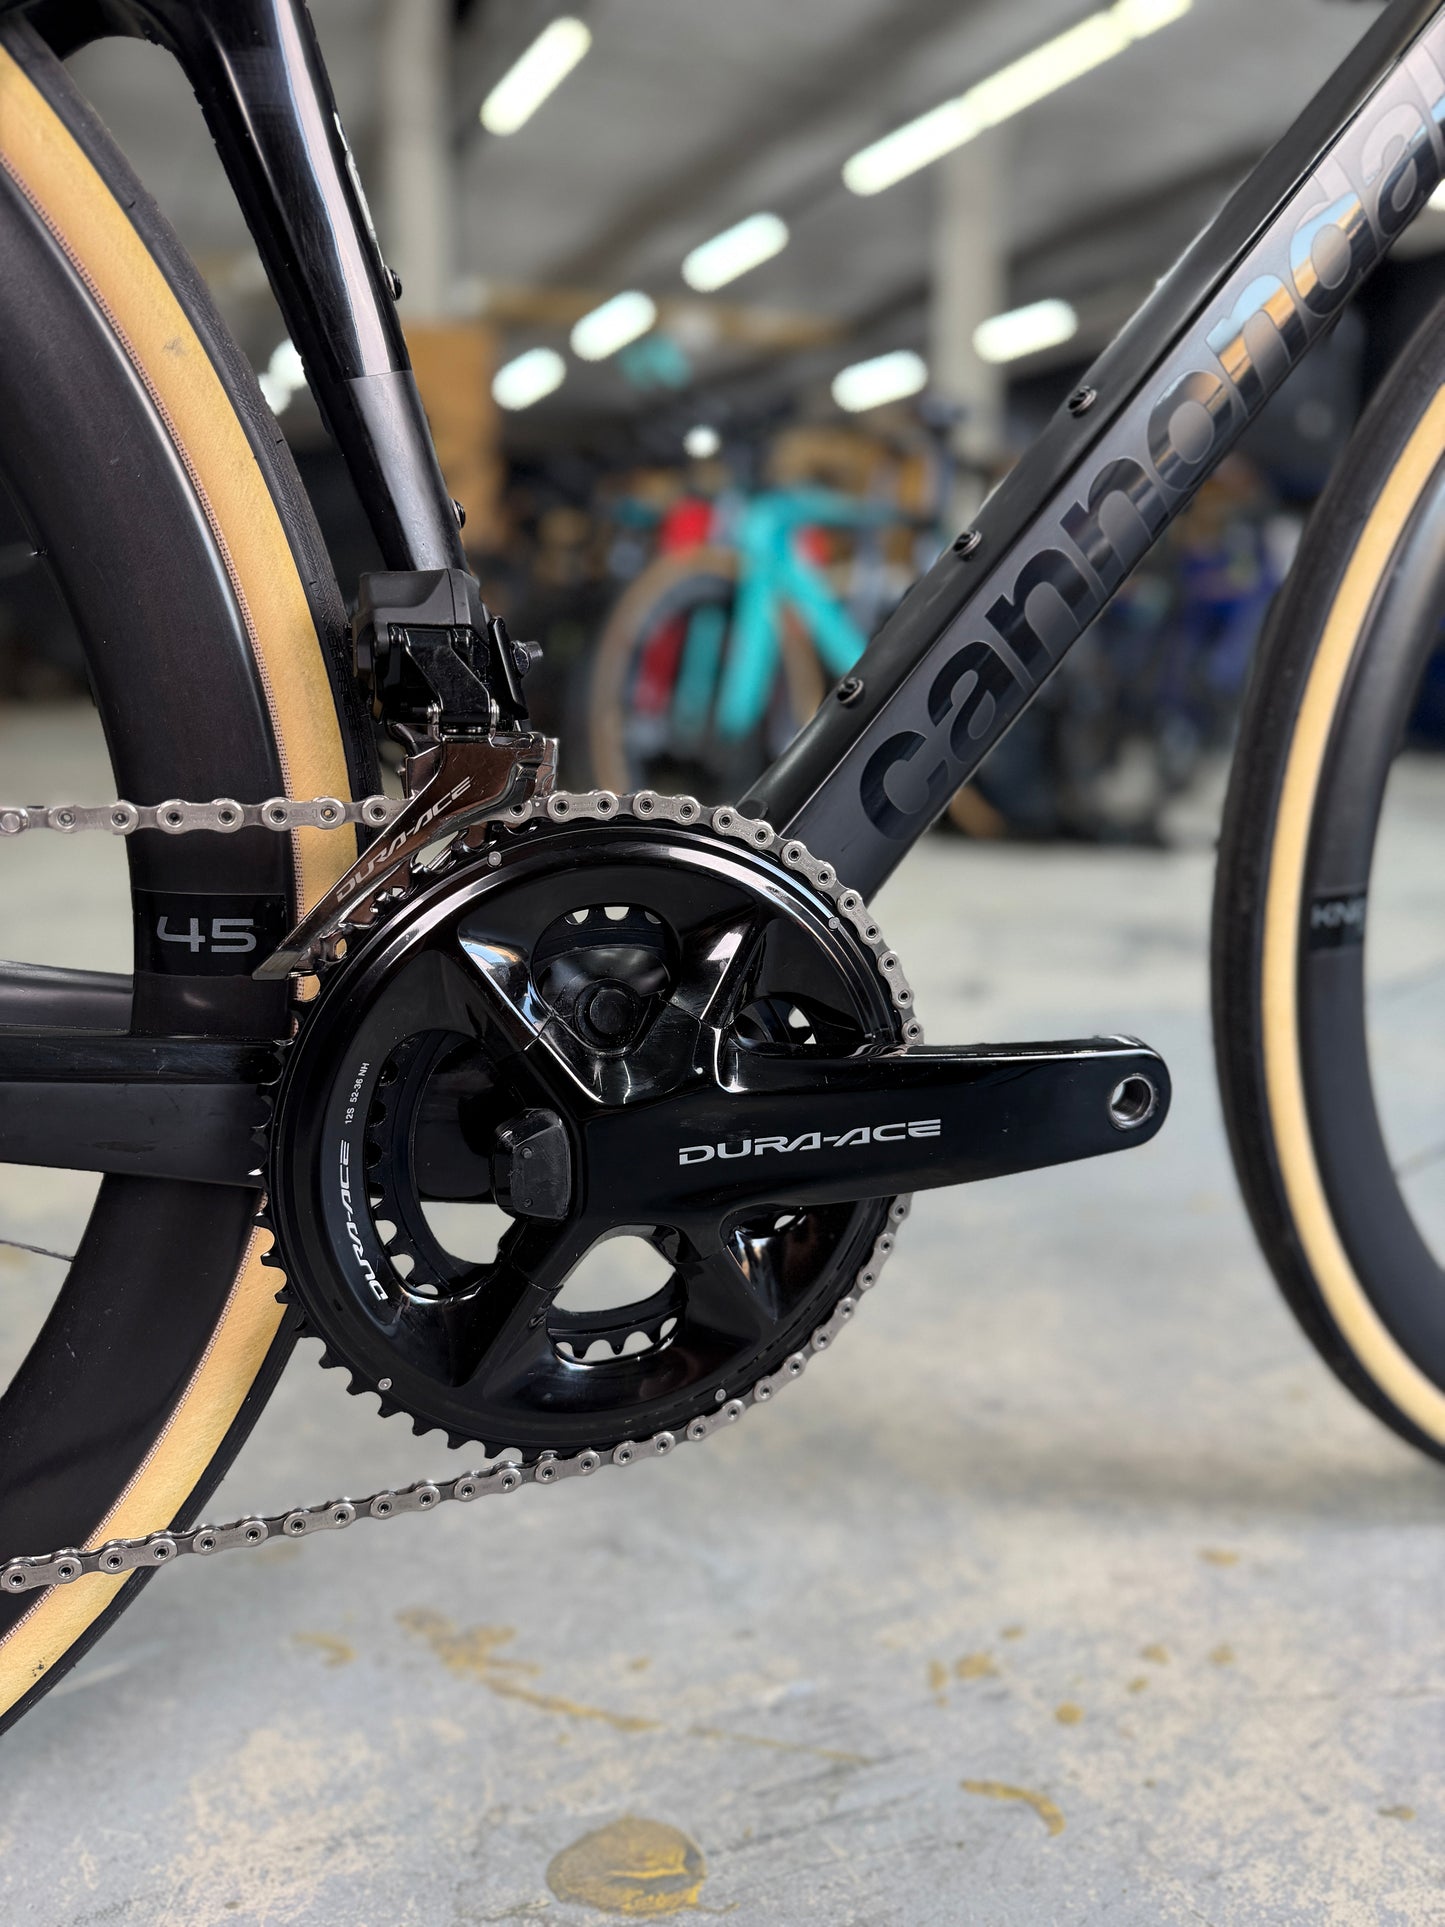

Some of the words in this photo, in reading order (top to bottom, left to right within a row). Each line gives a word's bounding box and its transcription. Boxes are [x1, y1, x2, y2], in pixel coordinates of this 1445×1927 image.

[336, 776, 472, 902] DURA-ACE
[157, 918, 257, 953] 45
[358, 1061, 371, 1077] NH
[349, 1078, 364, 1103] 52-36
[344, 1107, 355, 1125] 12S
[679, 1119, 941, 1166] DURA-ACE
[339, 1139, 389, 1302] DURA-ACE
